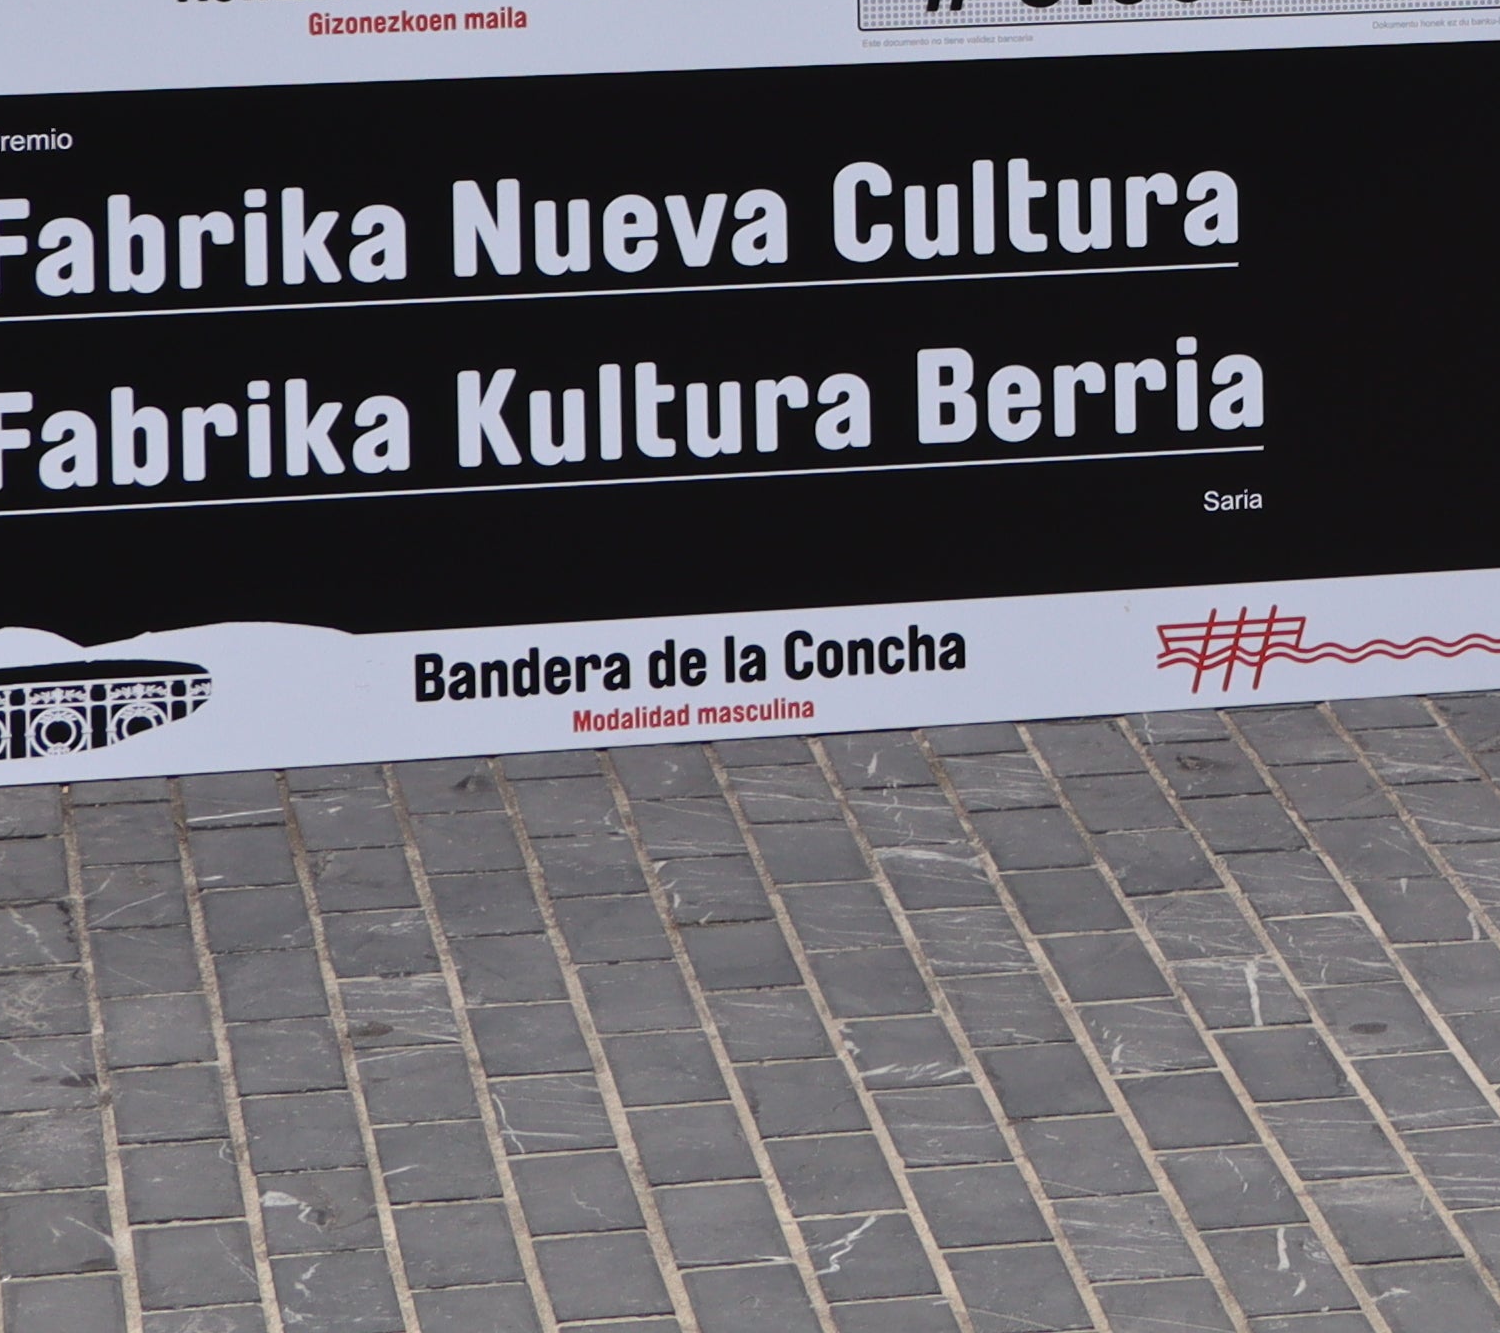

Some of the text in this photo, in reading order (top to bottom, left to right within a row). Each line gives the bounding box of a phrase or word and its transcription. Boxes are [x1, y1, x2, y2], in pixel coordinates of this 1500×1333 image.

[309, 8, 528, 36] Gizonezkoen maila
[862, 38, 881, 48] Este
[883, 37, 930, 47] documento
[452, 178, 788, 277] Nueva
[833, 158, 1240, 264] Cultura
[457, 362, 872, 468] Kultura
[917, 336, 1265, 445] Berria
[1203, 489, 1264, 513] Saria
[414, 624, 966, 703] Bandera de la Concha
[572, 699, 815, 733] Modalidad masculina
